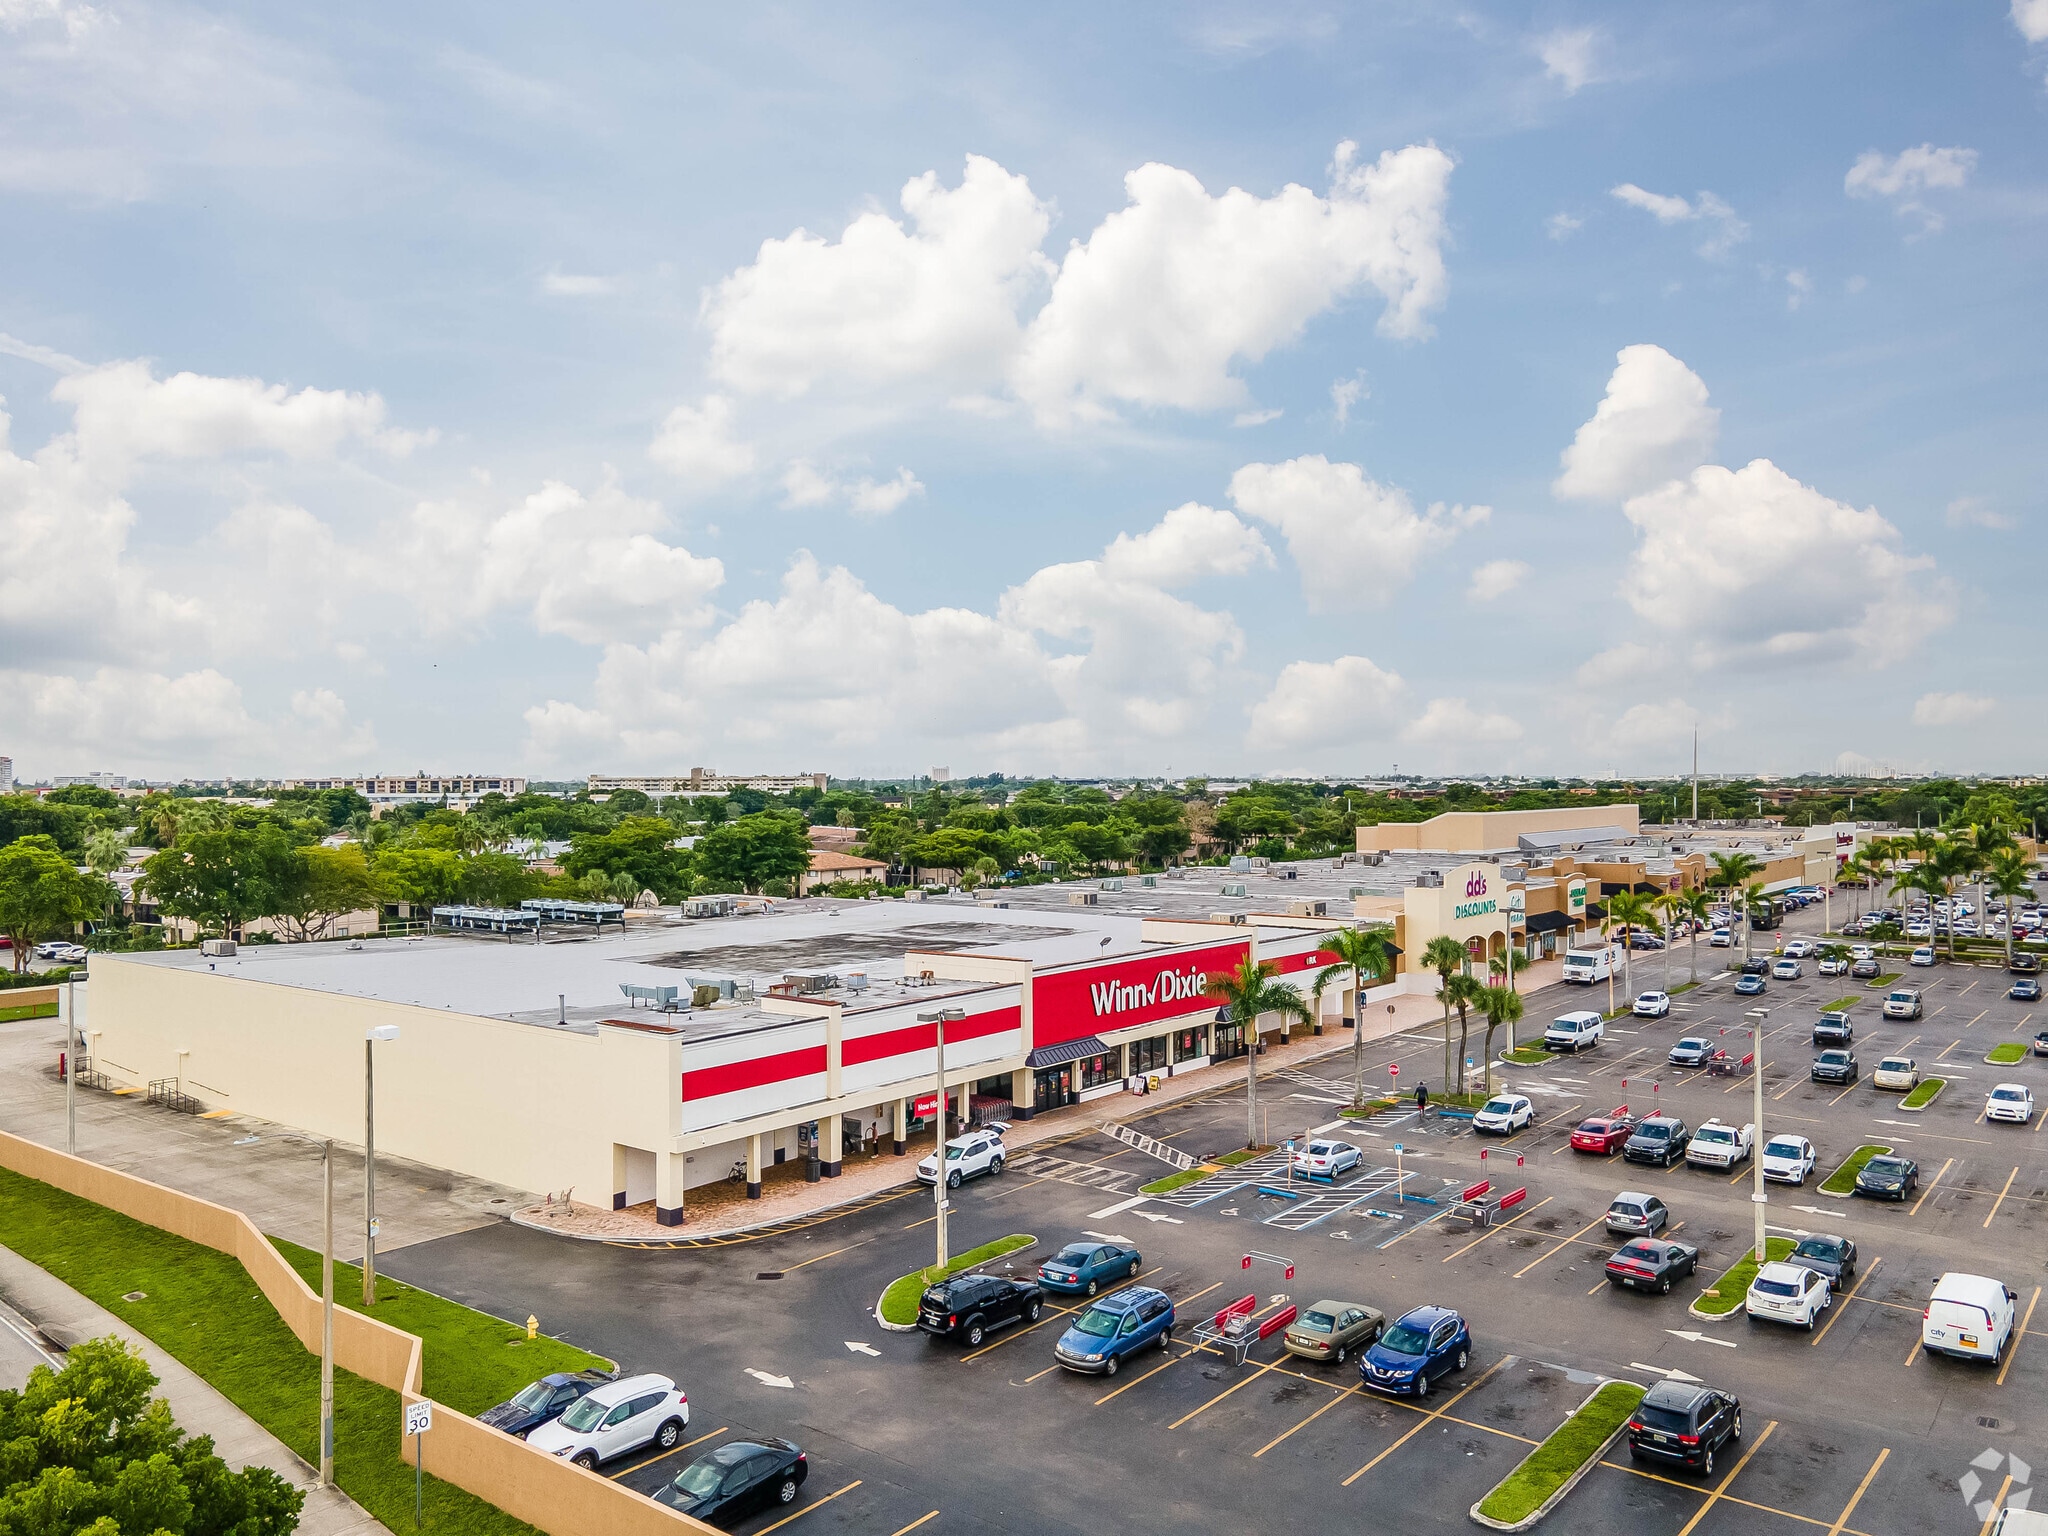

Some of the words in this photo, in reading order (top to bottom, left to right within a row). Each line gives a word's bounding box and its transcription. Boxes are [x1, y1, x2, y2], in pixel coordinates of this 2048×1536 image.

[1466, 870, 1487, 898] dd's
[1455, 899, 1497, 920] DISCOUNTS
[1930, 1329, 1946, 1338] city
[408, 1403, 430, 1413] SPEED
[410, 1410, 428, 1419] LIMIT
[409, 1416, 429, 1431] 30
